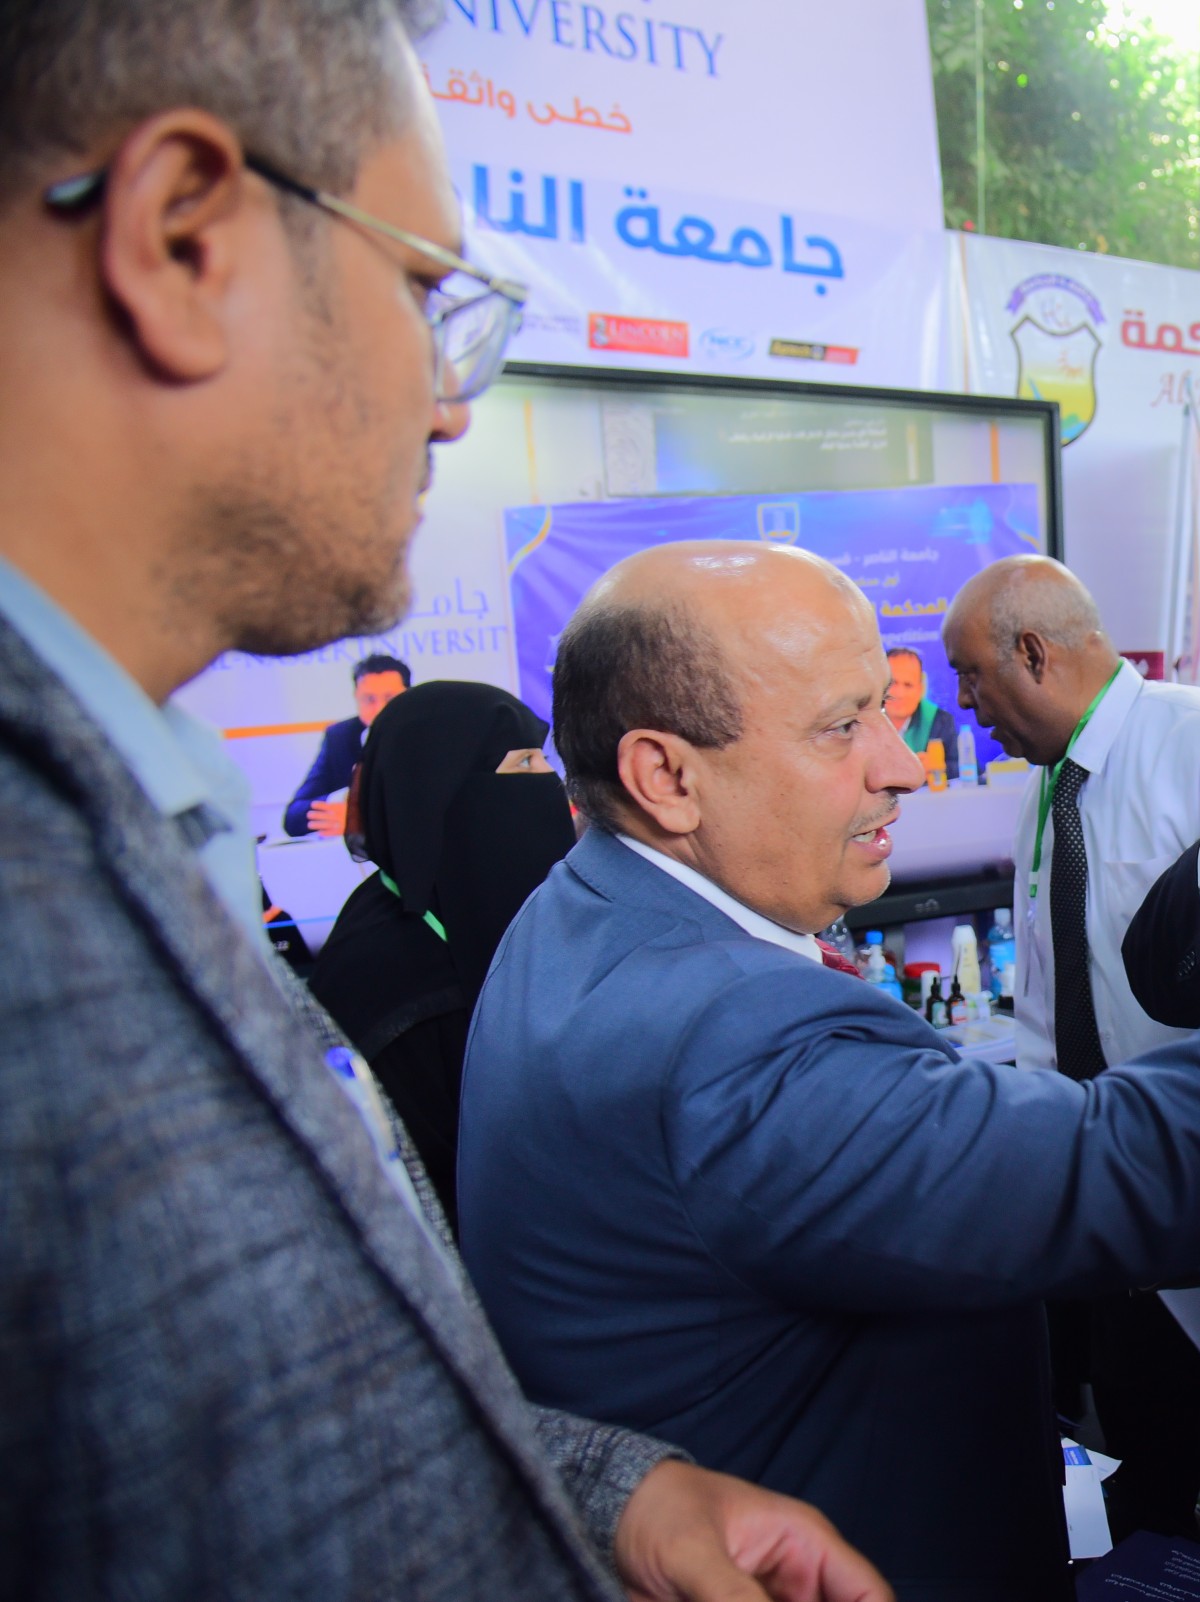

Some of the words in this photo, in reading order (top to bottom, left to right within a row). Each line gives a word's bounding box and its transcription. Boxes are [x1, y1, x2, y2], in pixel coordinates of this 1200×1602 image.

[450, 0, 725, 78] NIVERSITY
[421, 62, 516, 119] واثق
[472, 163, 586, 243] النا
[615, 186, 844, 297] جامعة
[408, 578, 490, 620] جام
